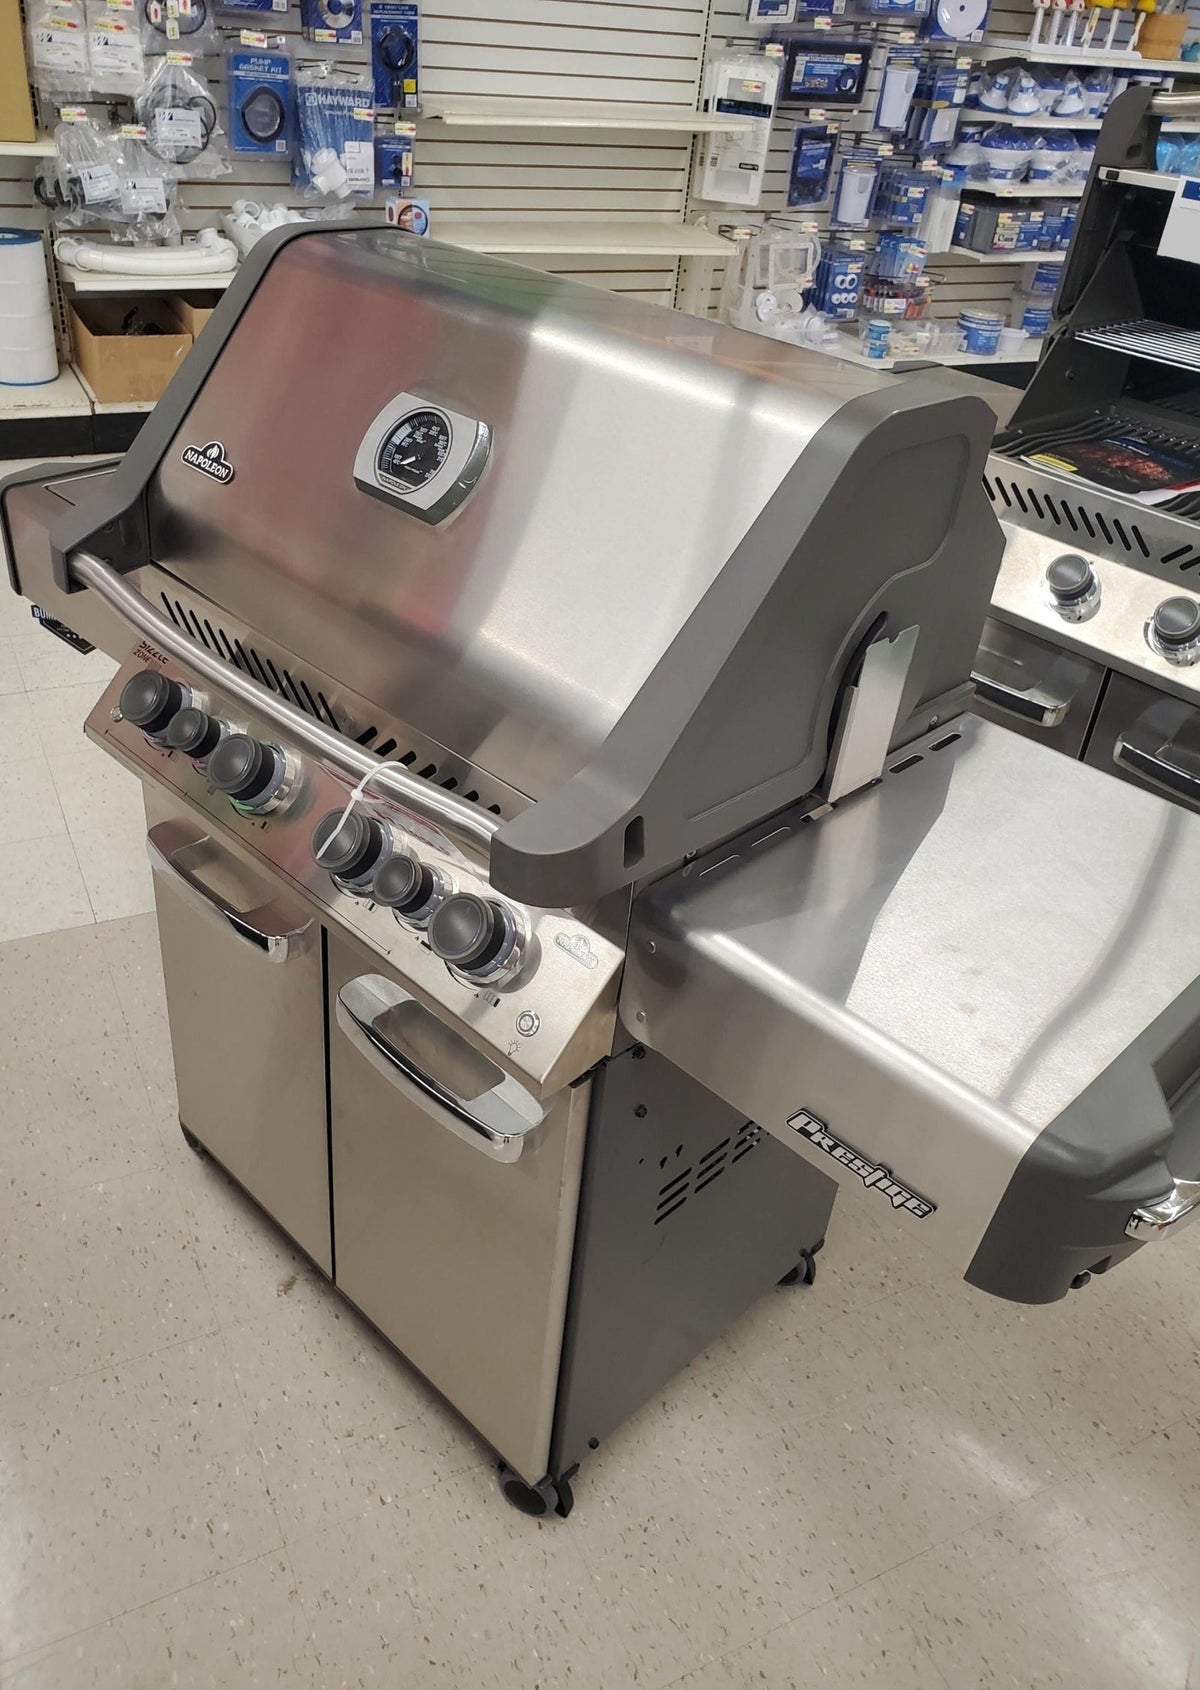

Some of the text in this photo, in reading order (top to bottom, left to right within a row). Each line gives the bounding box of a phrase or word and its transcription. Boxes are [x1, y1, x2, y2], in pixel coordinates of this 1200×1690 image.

[318, 93, 371, 107] HAYWARD
[184, 449, 229, 478] NAPOLEON
[133, 648, 152, 663] ZONE
[139, 640, 170, 664] SIZZLE
